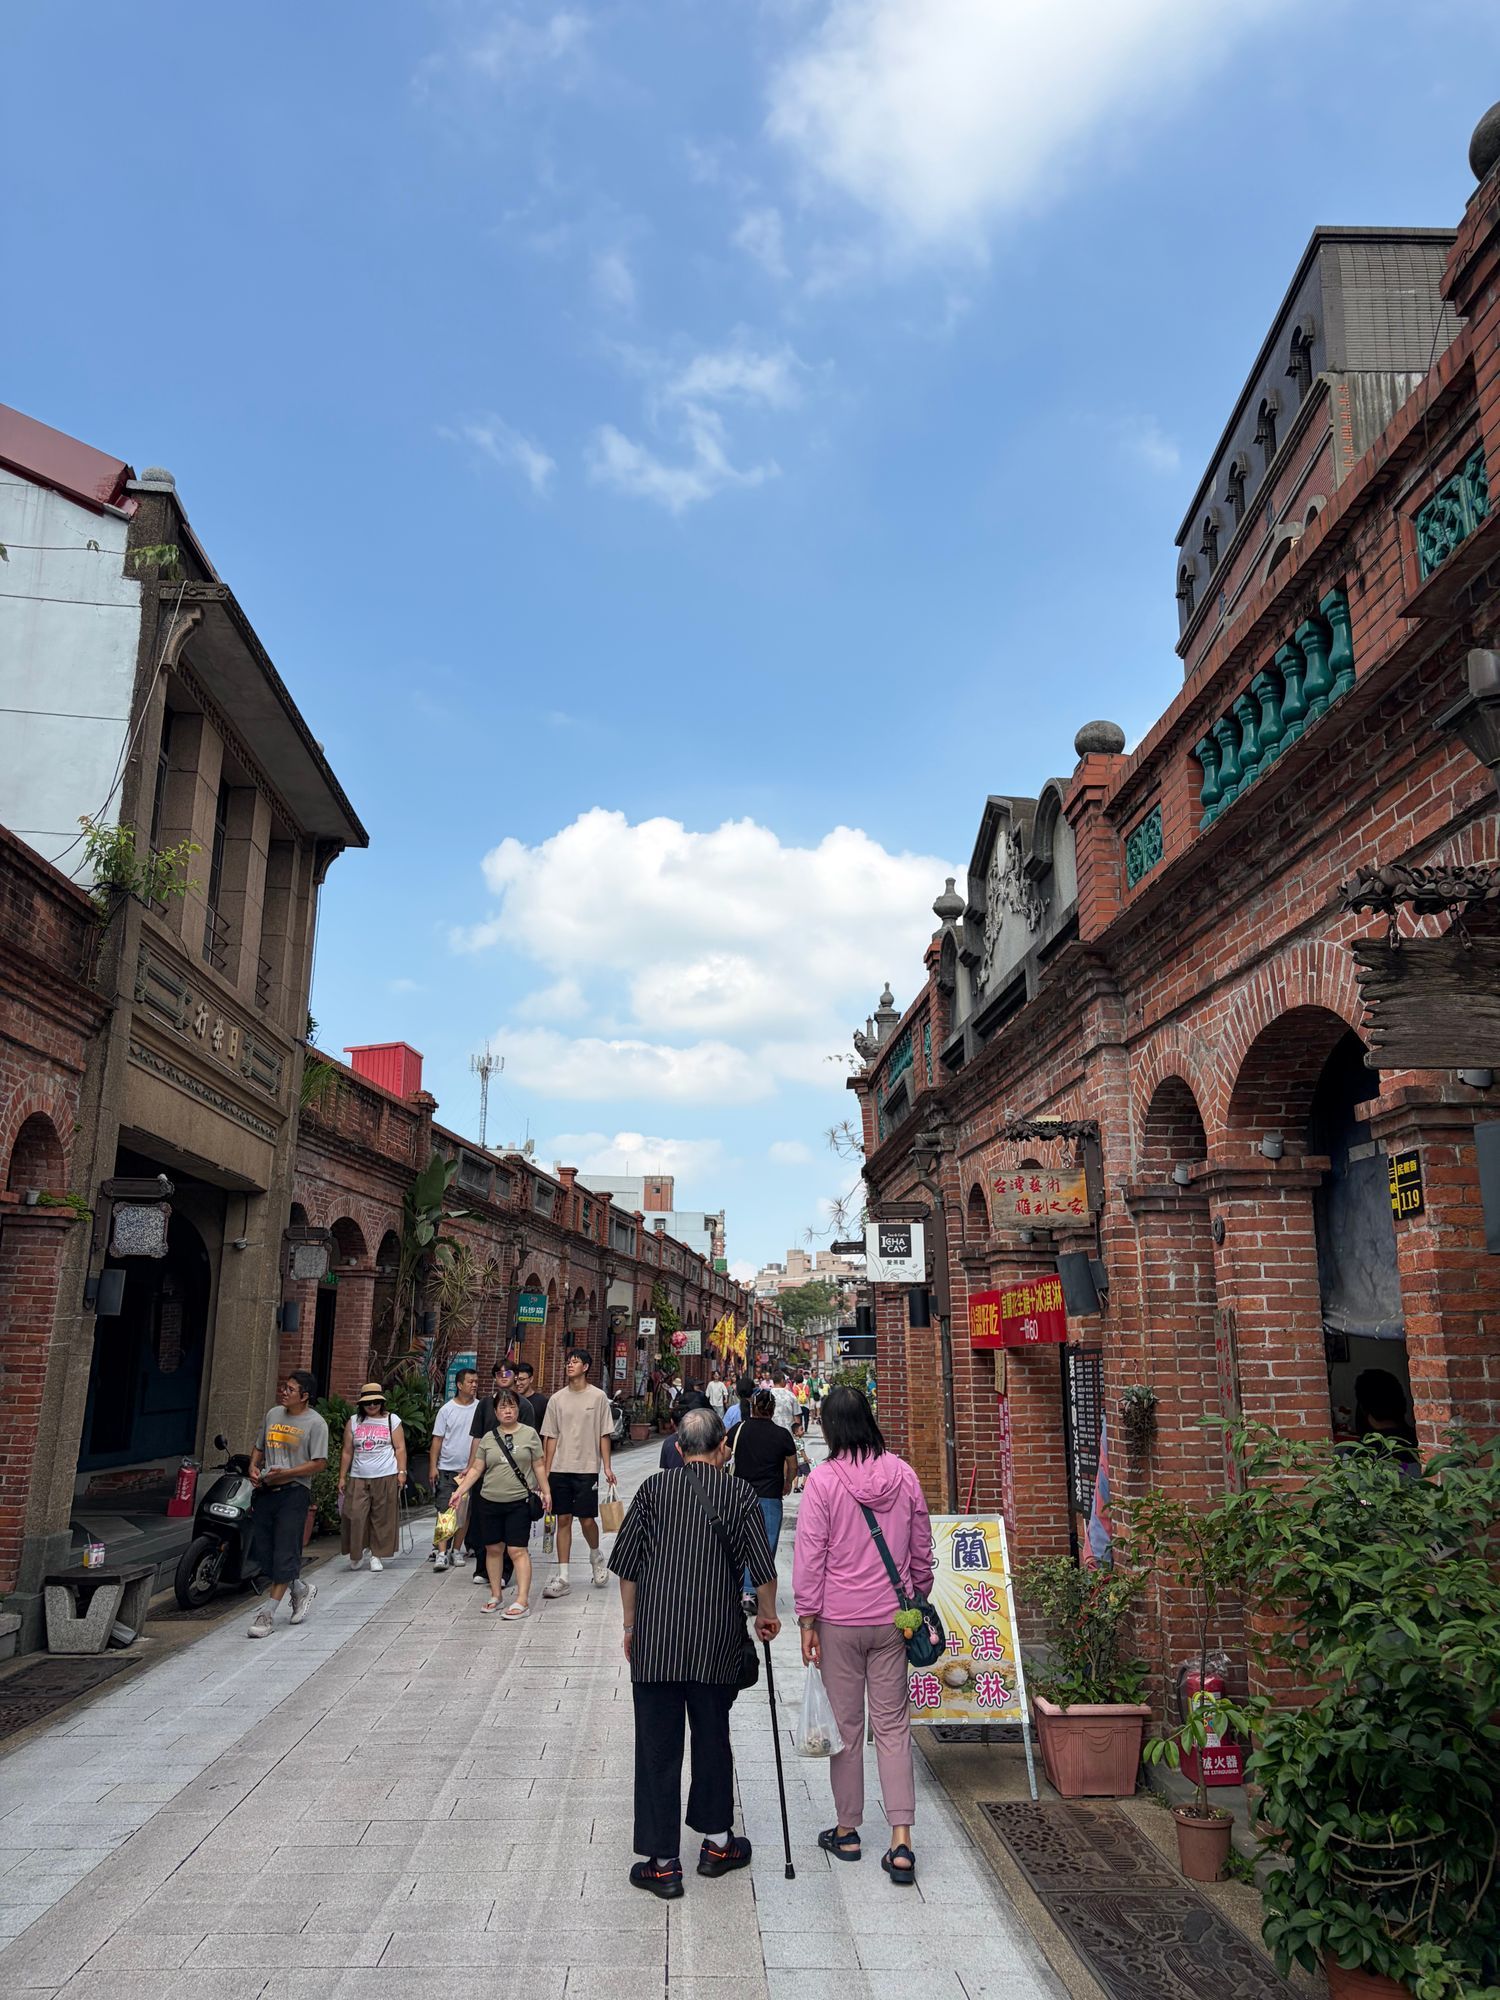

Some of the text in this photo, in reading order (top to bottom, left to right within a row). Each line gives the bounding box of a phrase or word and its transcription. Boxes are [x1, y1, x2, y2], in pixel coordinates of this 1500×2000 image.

[993, 1176, 1060, 1193] 台灣藝術
[1015, 1198, 1084, 1215] 雕刻之家
[1401, 1189, 1419, 1210] 119
[964, 1582, 1010, 1707] 冰淇淋
[909, 1673, 941, 1707] 糖
